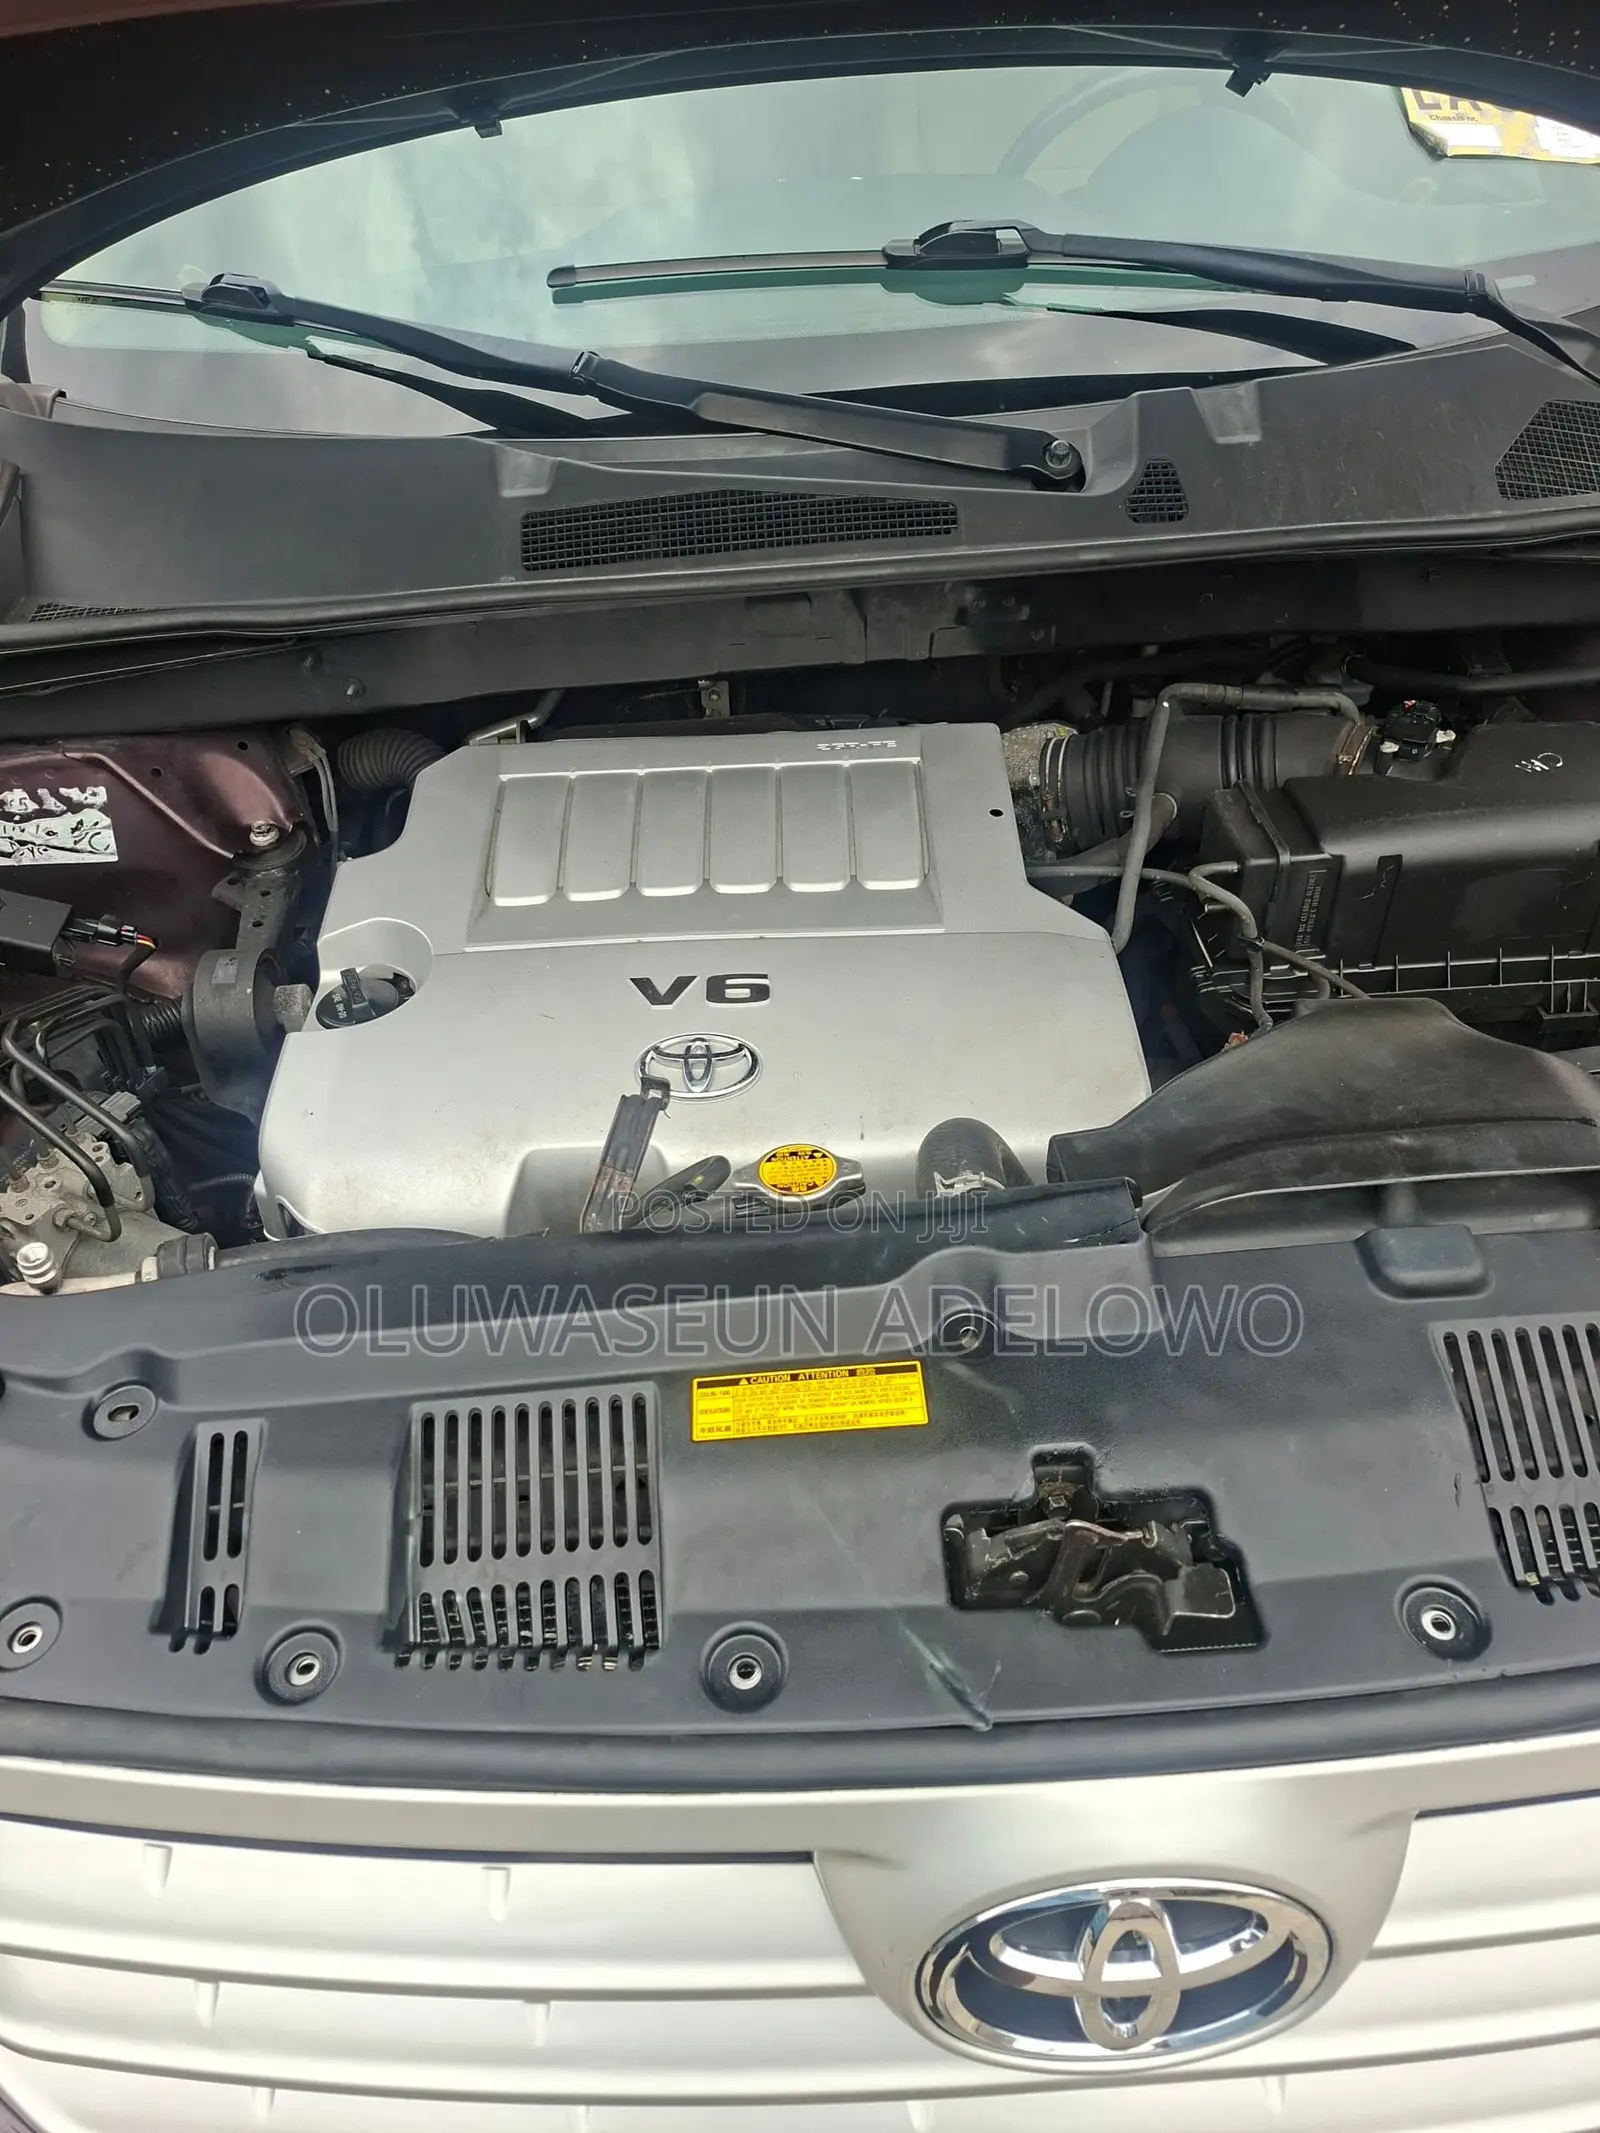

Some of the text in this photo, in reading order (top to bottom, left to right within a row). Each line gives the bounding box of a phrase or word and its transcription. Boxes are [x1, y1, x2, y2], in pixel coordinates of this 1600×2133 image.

[1429, 114, 1465, 122] Chassis
[628, 973, 770, 1009] V6
[750, 1369, 849, 1384] CAUTION ATTENTION
